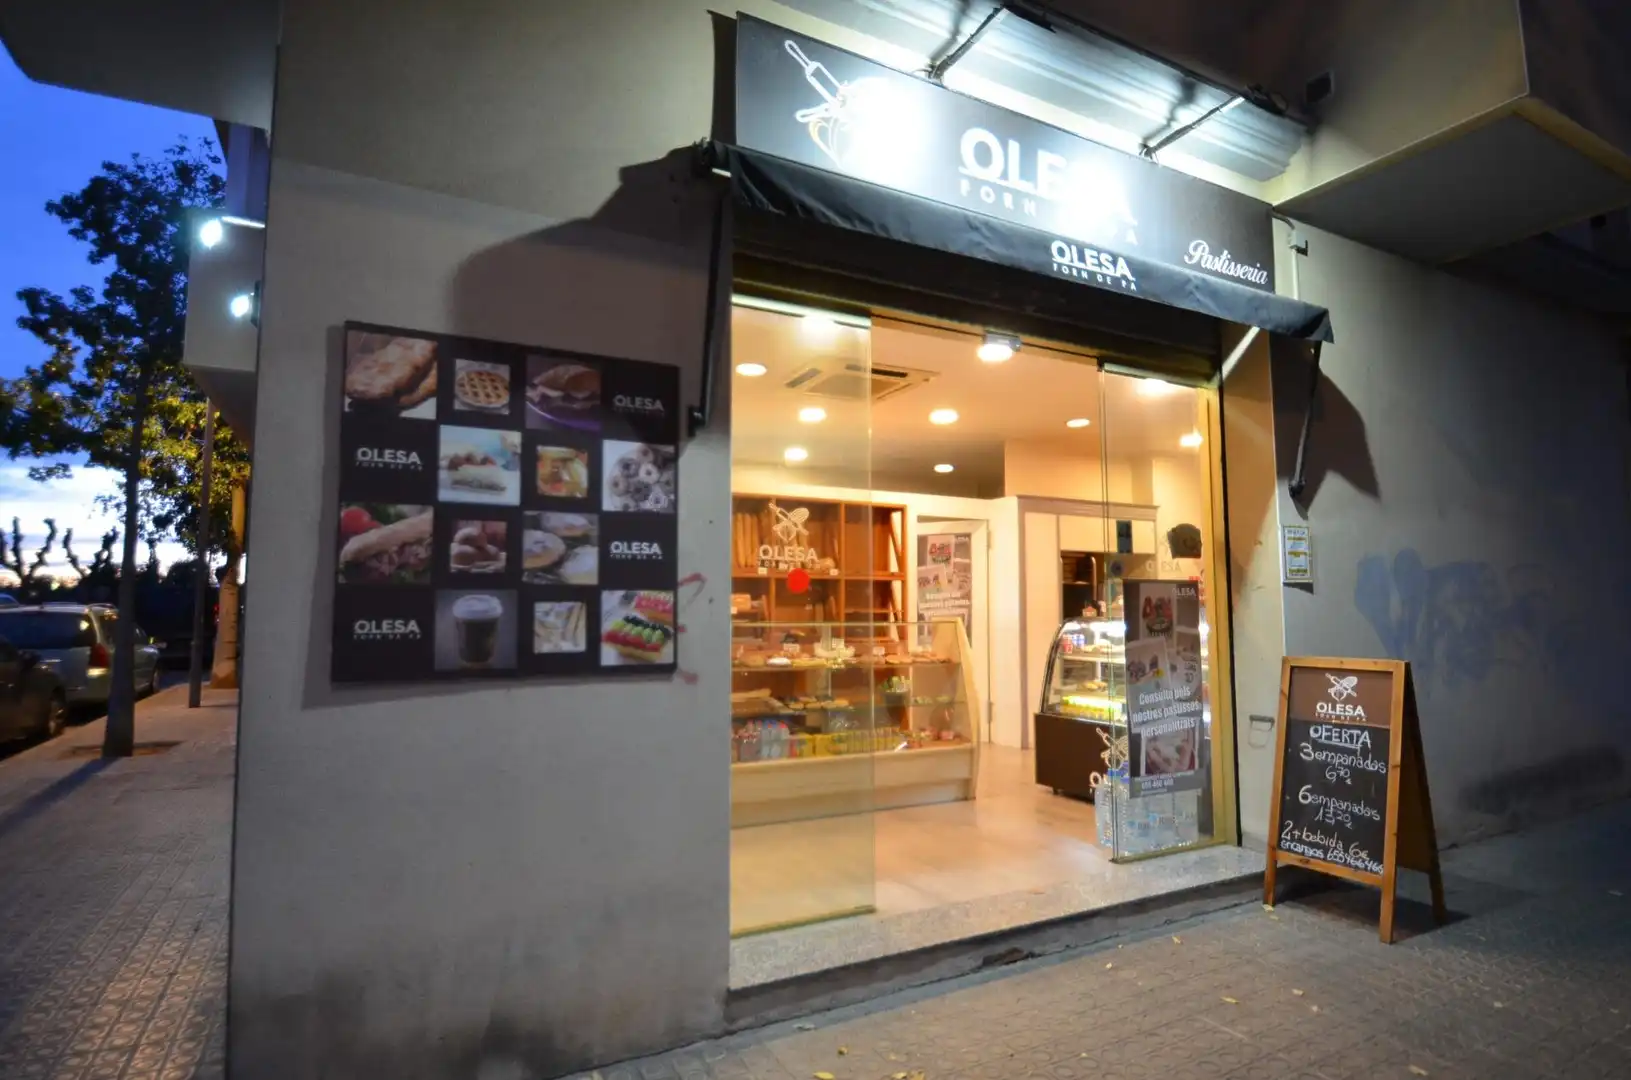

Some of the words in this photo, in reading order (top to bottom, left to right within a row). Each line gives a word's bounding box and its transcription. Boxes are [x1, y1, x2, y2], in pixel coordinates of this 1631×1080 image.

[959, 179, 1036, 217] FORN
[1051, 240, 1135, 281] OLESA
[1184, 239, 1268, 285] Pastisseria
[1053, 262, 1088, 280] FORN
[1097, 273, 1112, 286] DE
[1121, 278, 1137, 292] PA
[613, 394, 665, 411] OLESA
[357, 447, 421, 465] OLESA
[610, 541, 663, 555] OLESA
[759, 545, 819, 562] OLESA
[354, 619, 421, 634] OLESA
[1316, 702, 1367, 718] OLESA
[1309, 724, 1372, 752] OFERTA
